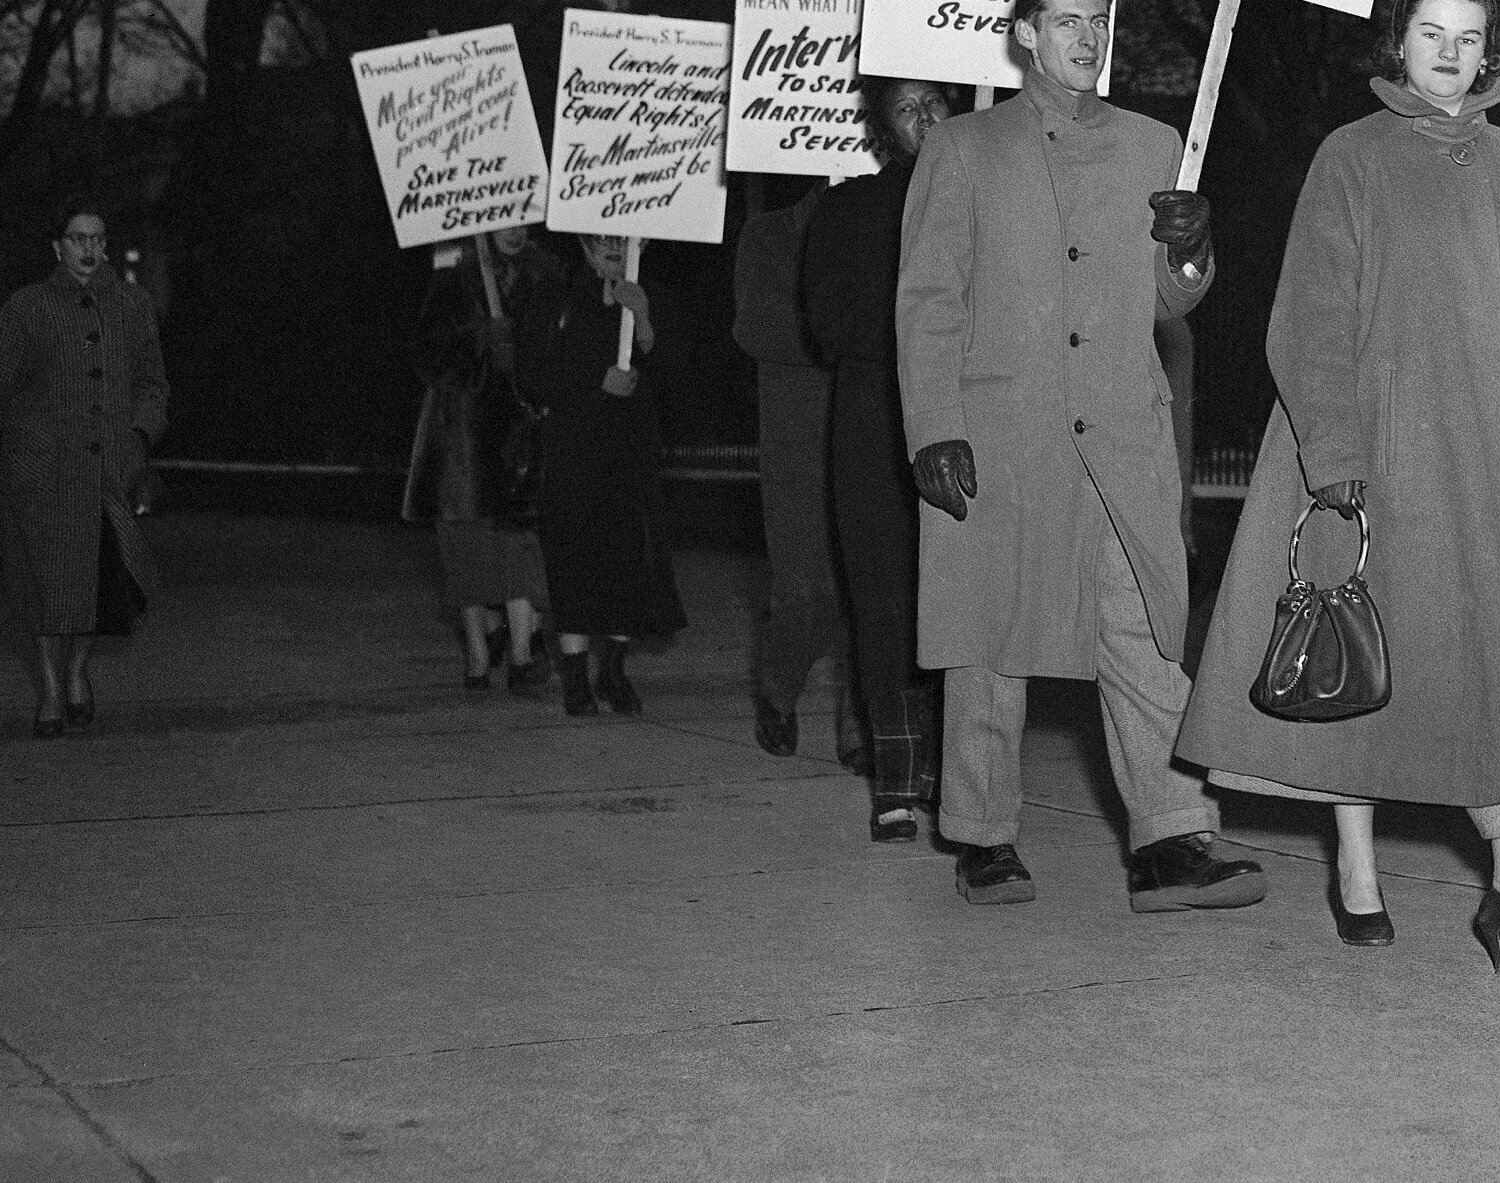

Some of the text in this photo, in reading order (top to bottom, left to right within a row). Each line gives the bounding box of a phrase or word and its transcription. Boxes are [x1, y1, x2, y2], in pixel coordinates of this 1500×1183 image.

[927, 1, 1014, 35] SEVE
[608, 48, 679, 76] Lincoln
[742, 26, 861, 81] Interv
[443, 63, 506, 113] Rights
[563, 68, 656, 98] Roosevelt
[777, 73, 863, 94] TO SAV
[562, 96, 630, 125] Equal
[741, 97, 870, 125] MARTINSV
[564, 125, 724, 172] The Martinsville
[408, 156, 507, 191] SAVE THE
[559, 151, 711, 200] Seven must be
[398, 174, 540, 220] MARTINSVILLE
[601, 182, 682, 219] Saved
